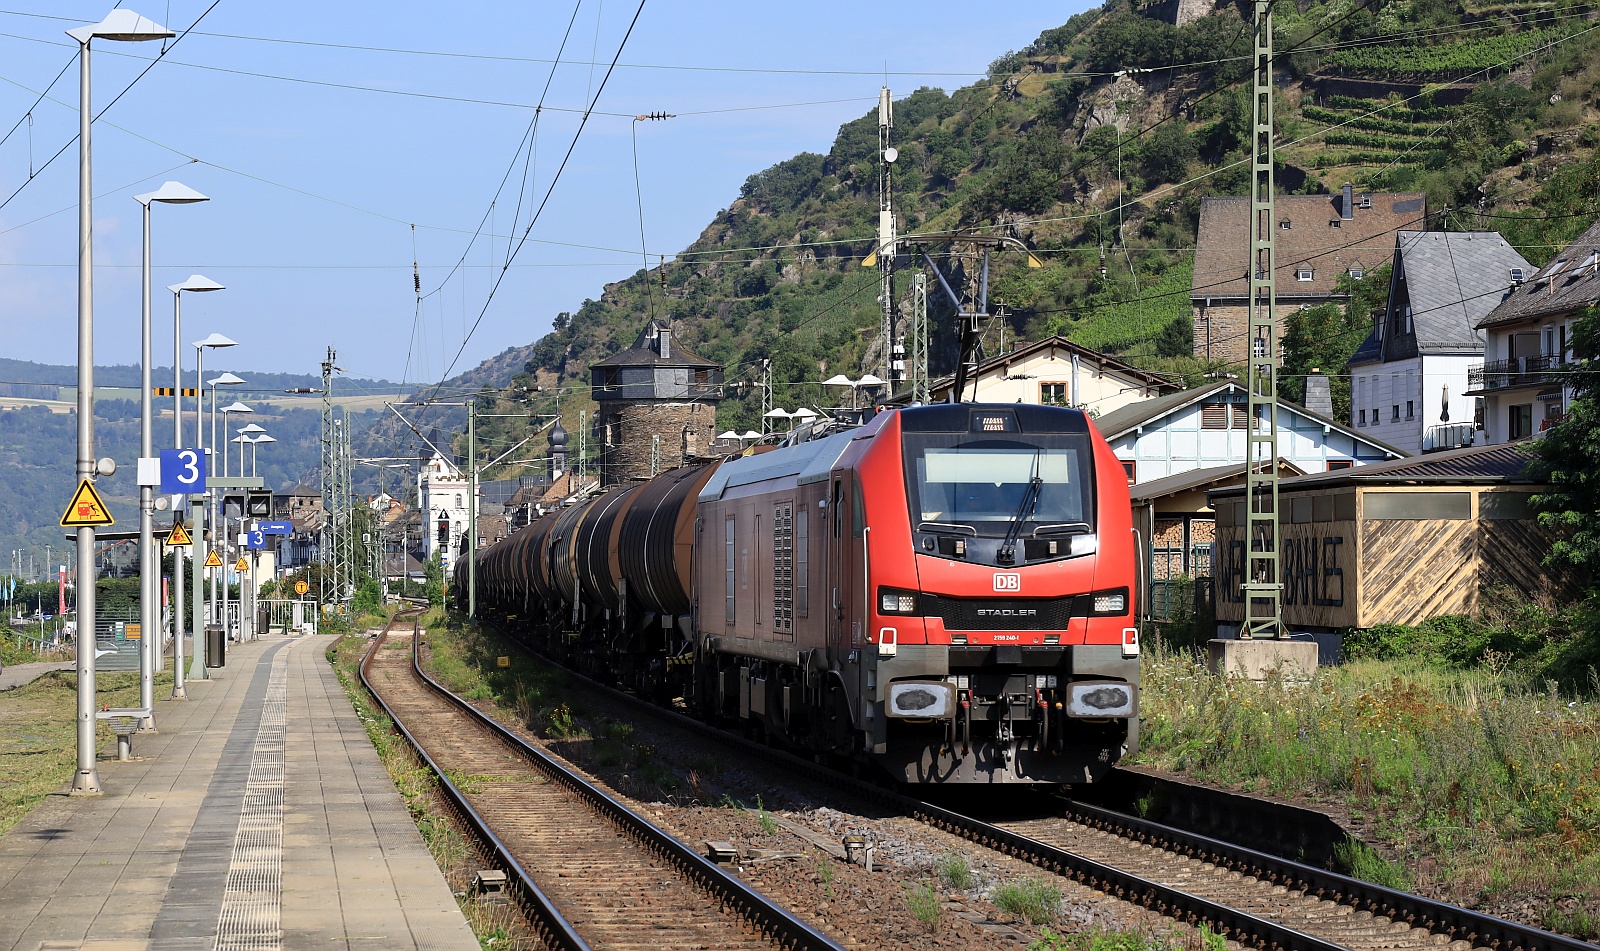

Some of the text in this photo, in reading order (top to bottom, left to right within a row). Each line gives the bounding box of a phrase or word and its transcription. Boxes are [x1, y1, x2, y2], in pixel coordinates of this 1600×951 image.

[176, 450, 199, 484] 3
[253, 531, 264, 545] 3
[996, 575, 1018, 589] DB
[1284, 537, 1344, 608] BAHLES
